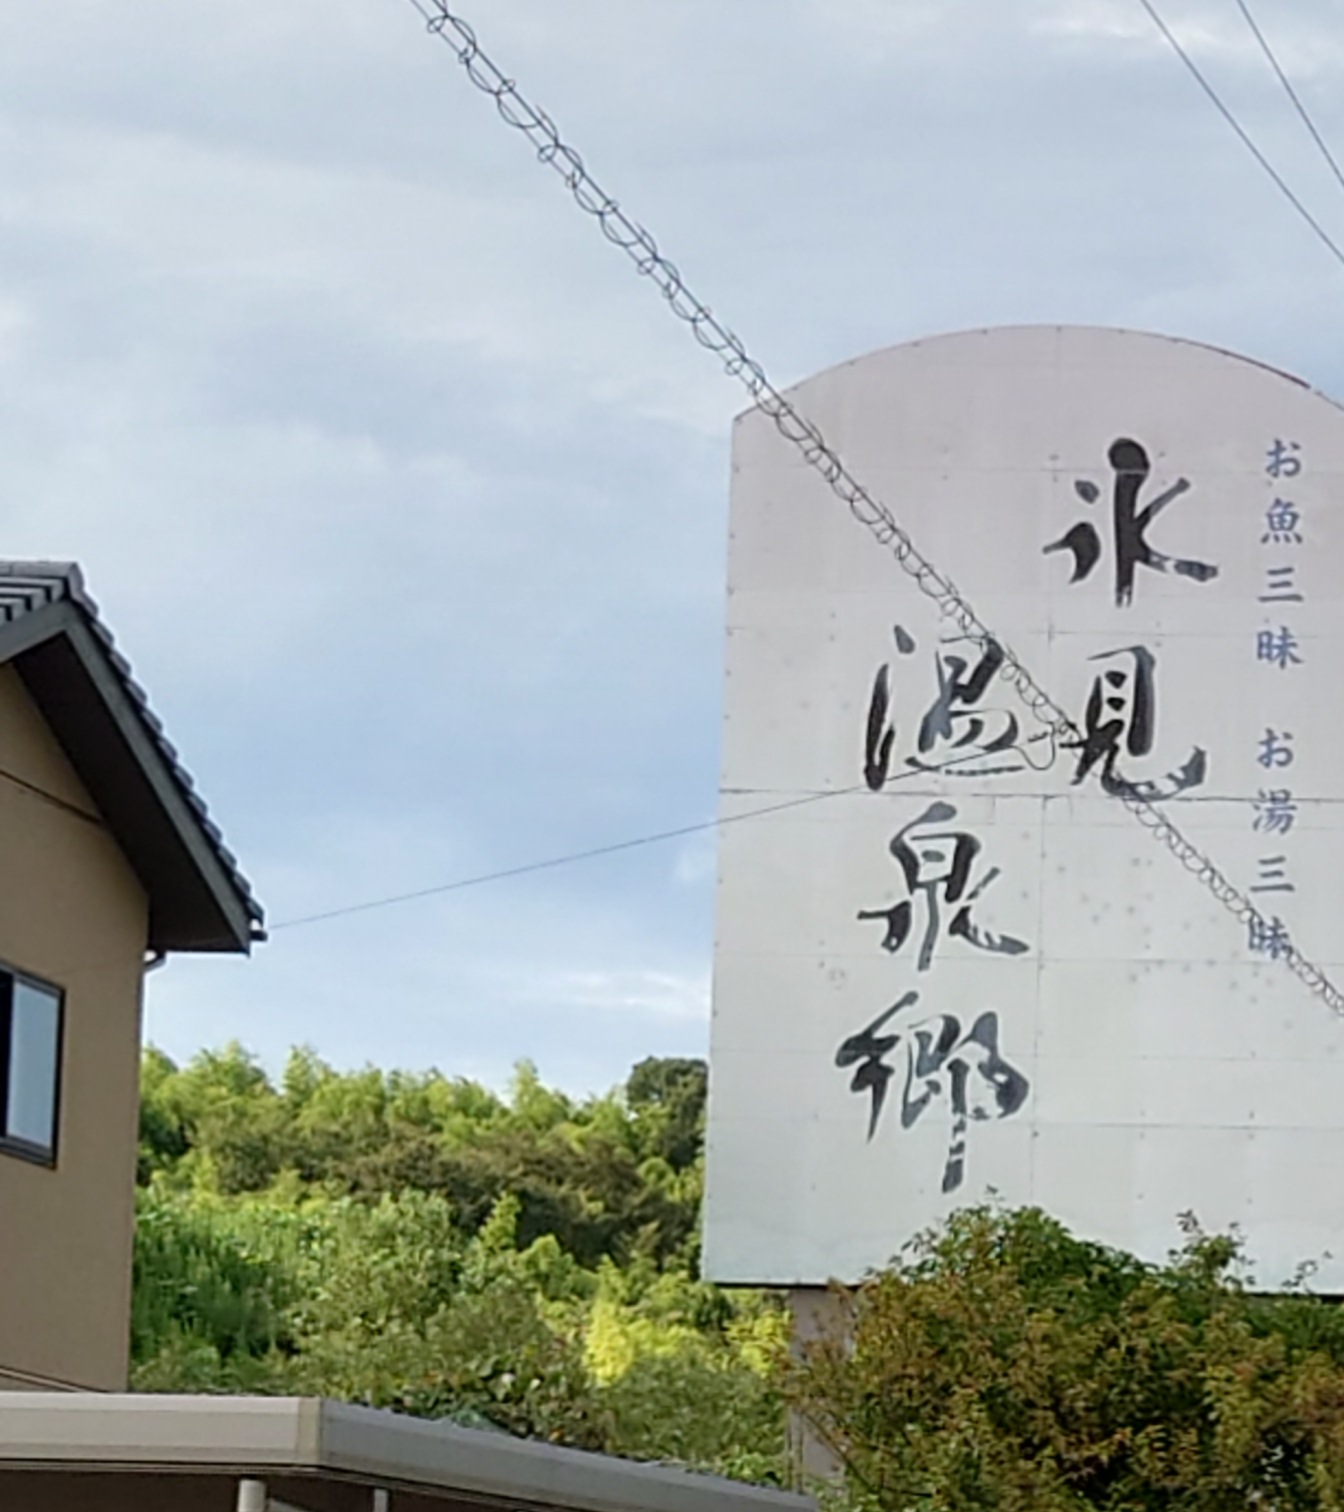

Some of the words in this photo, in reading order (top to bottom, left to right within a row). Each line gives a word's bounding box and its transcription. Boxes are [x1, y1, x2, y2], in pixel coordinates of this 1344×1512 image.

[1042, 437, 1218, 801] 氷見
[1256, 439, 1304, 669] お魚三昧
[834, 624, 1030, 1193] 温泉郷
[1248, 727, 1297, 959] お湯三昧
